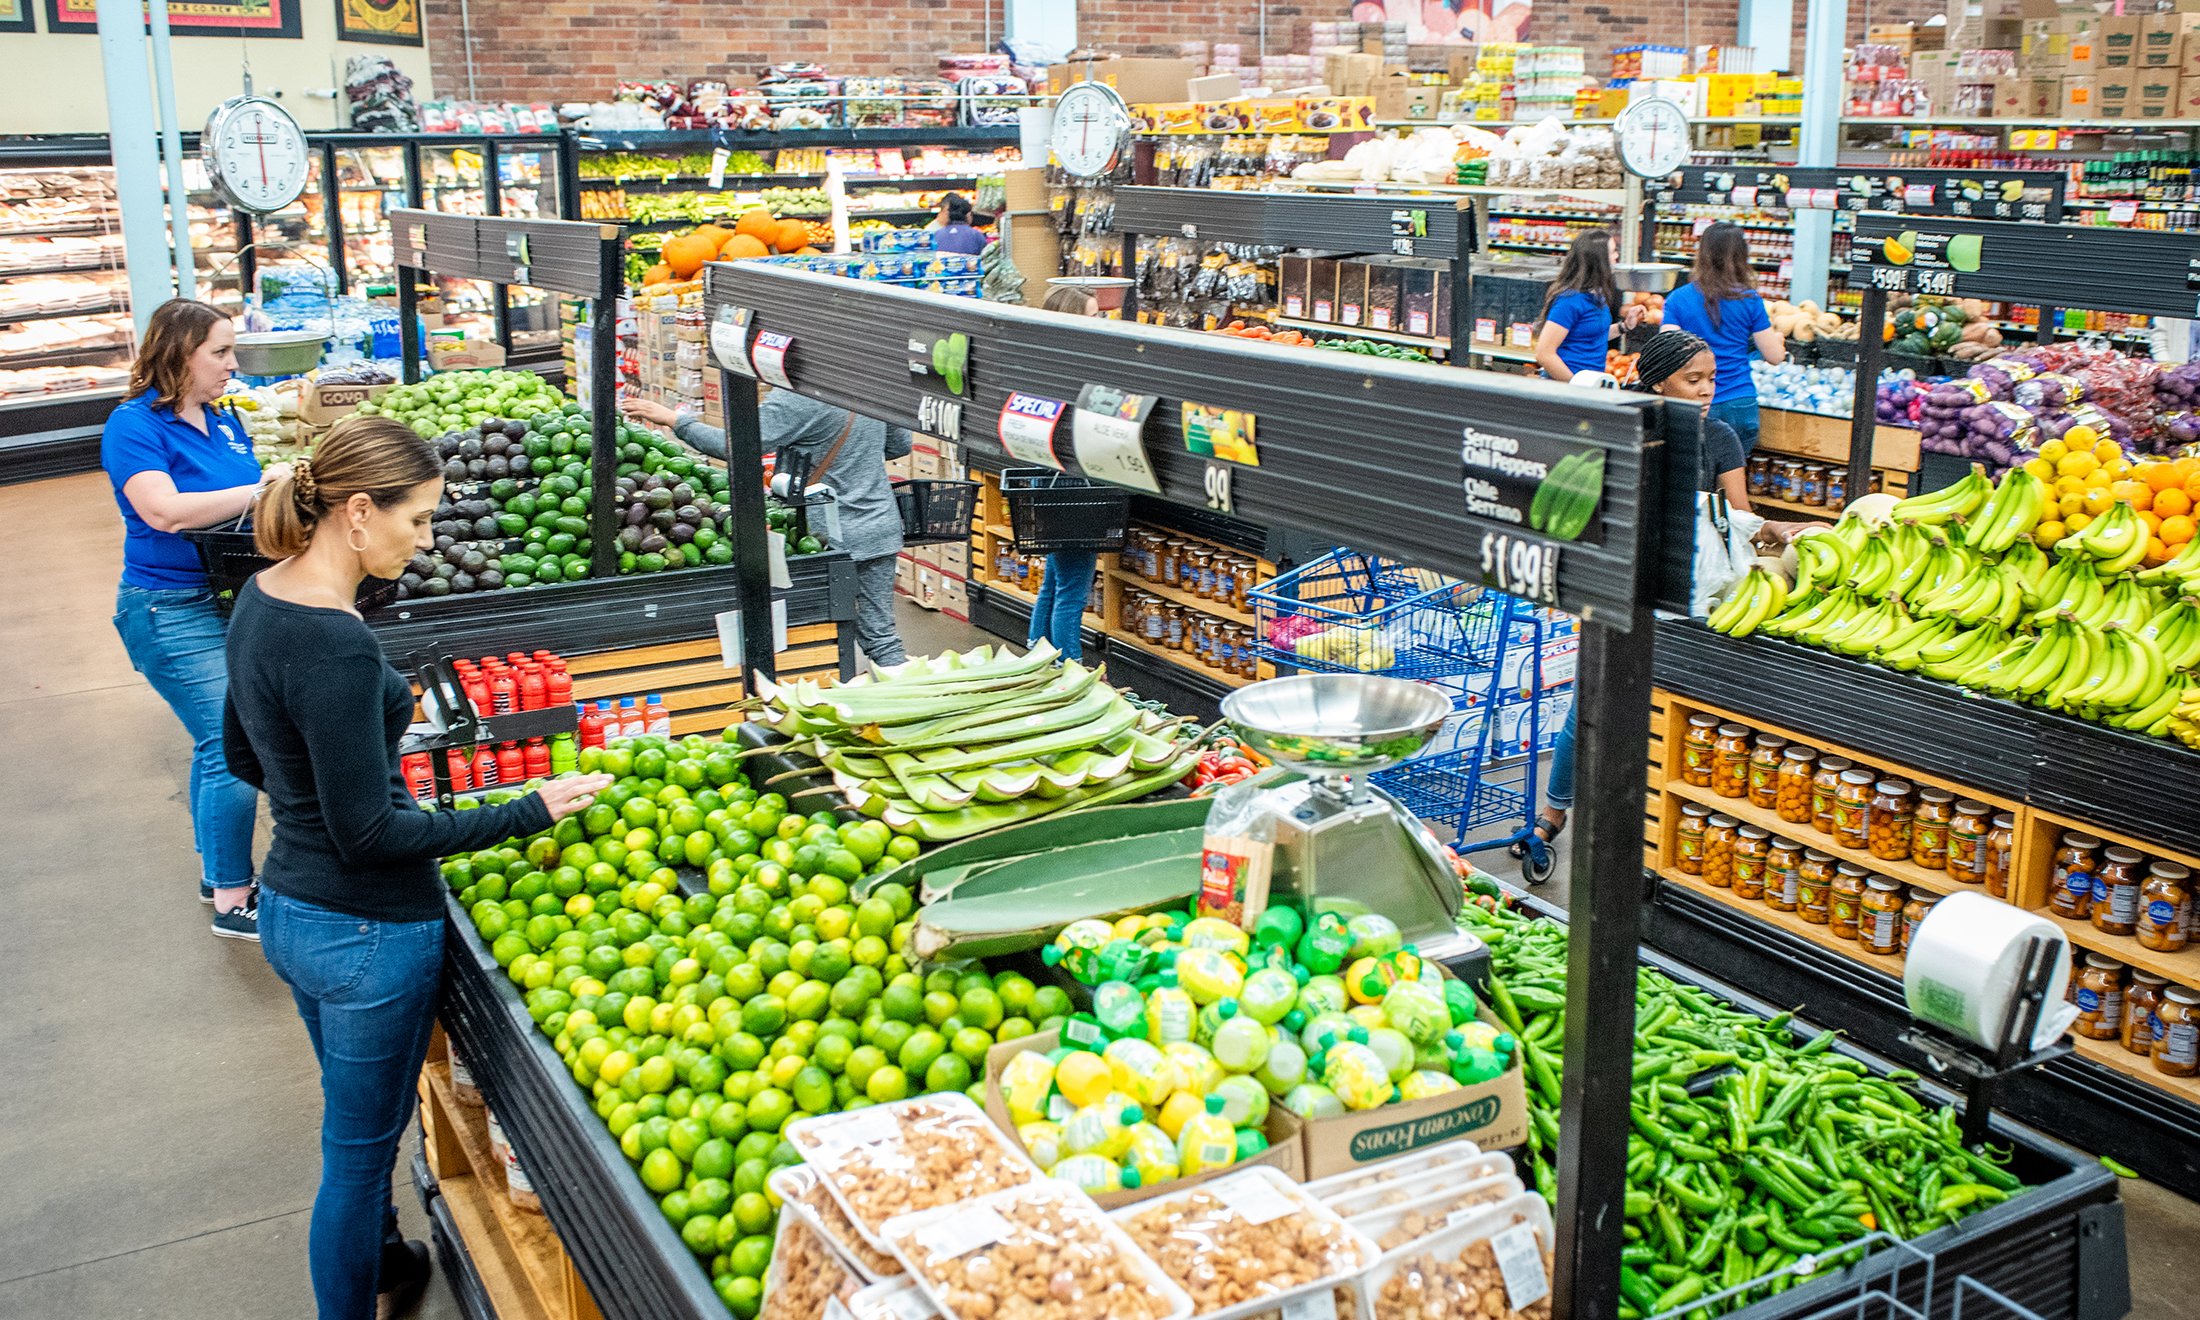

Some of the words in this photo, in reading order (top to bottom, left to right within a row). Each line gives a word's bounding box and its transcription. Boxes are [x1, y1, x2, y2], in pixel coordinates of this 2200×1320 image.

[255, 113, 262, 124] 0
[236, 120, 242, 132] 1
[273, 121, 279, 130] 9
[227, 136, 235, 149] 2
[286, 139, 293, 150] 8
[229, 161, 237, 174] 3
[288, 162, 296, 174] 7
[241, 180, 249, 189] 4
[278, 180, 286, 191] 6
[261, 185, 268, 198] 5
[323, 391, 365, 404] GOYA
[1009, 394, 1056, 419] SPECIAL
[1462, 427, 1519, 455] Serrano
[1116, 454, 1146, 475] 1.99
[1462, 446, 1492, 468] Chili
[1491, 451, 1549, 479] Peppers
[1204, 466, 1230, 512] 99
[1464, 477, 1499, 501] Chile
[1465, 495, 1523, 523] Serrano
[1418, 1099, 1497, 1137] CONCORD
[1355, 1123, 1417, 1154] FOODS
